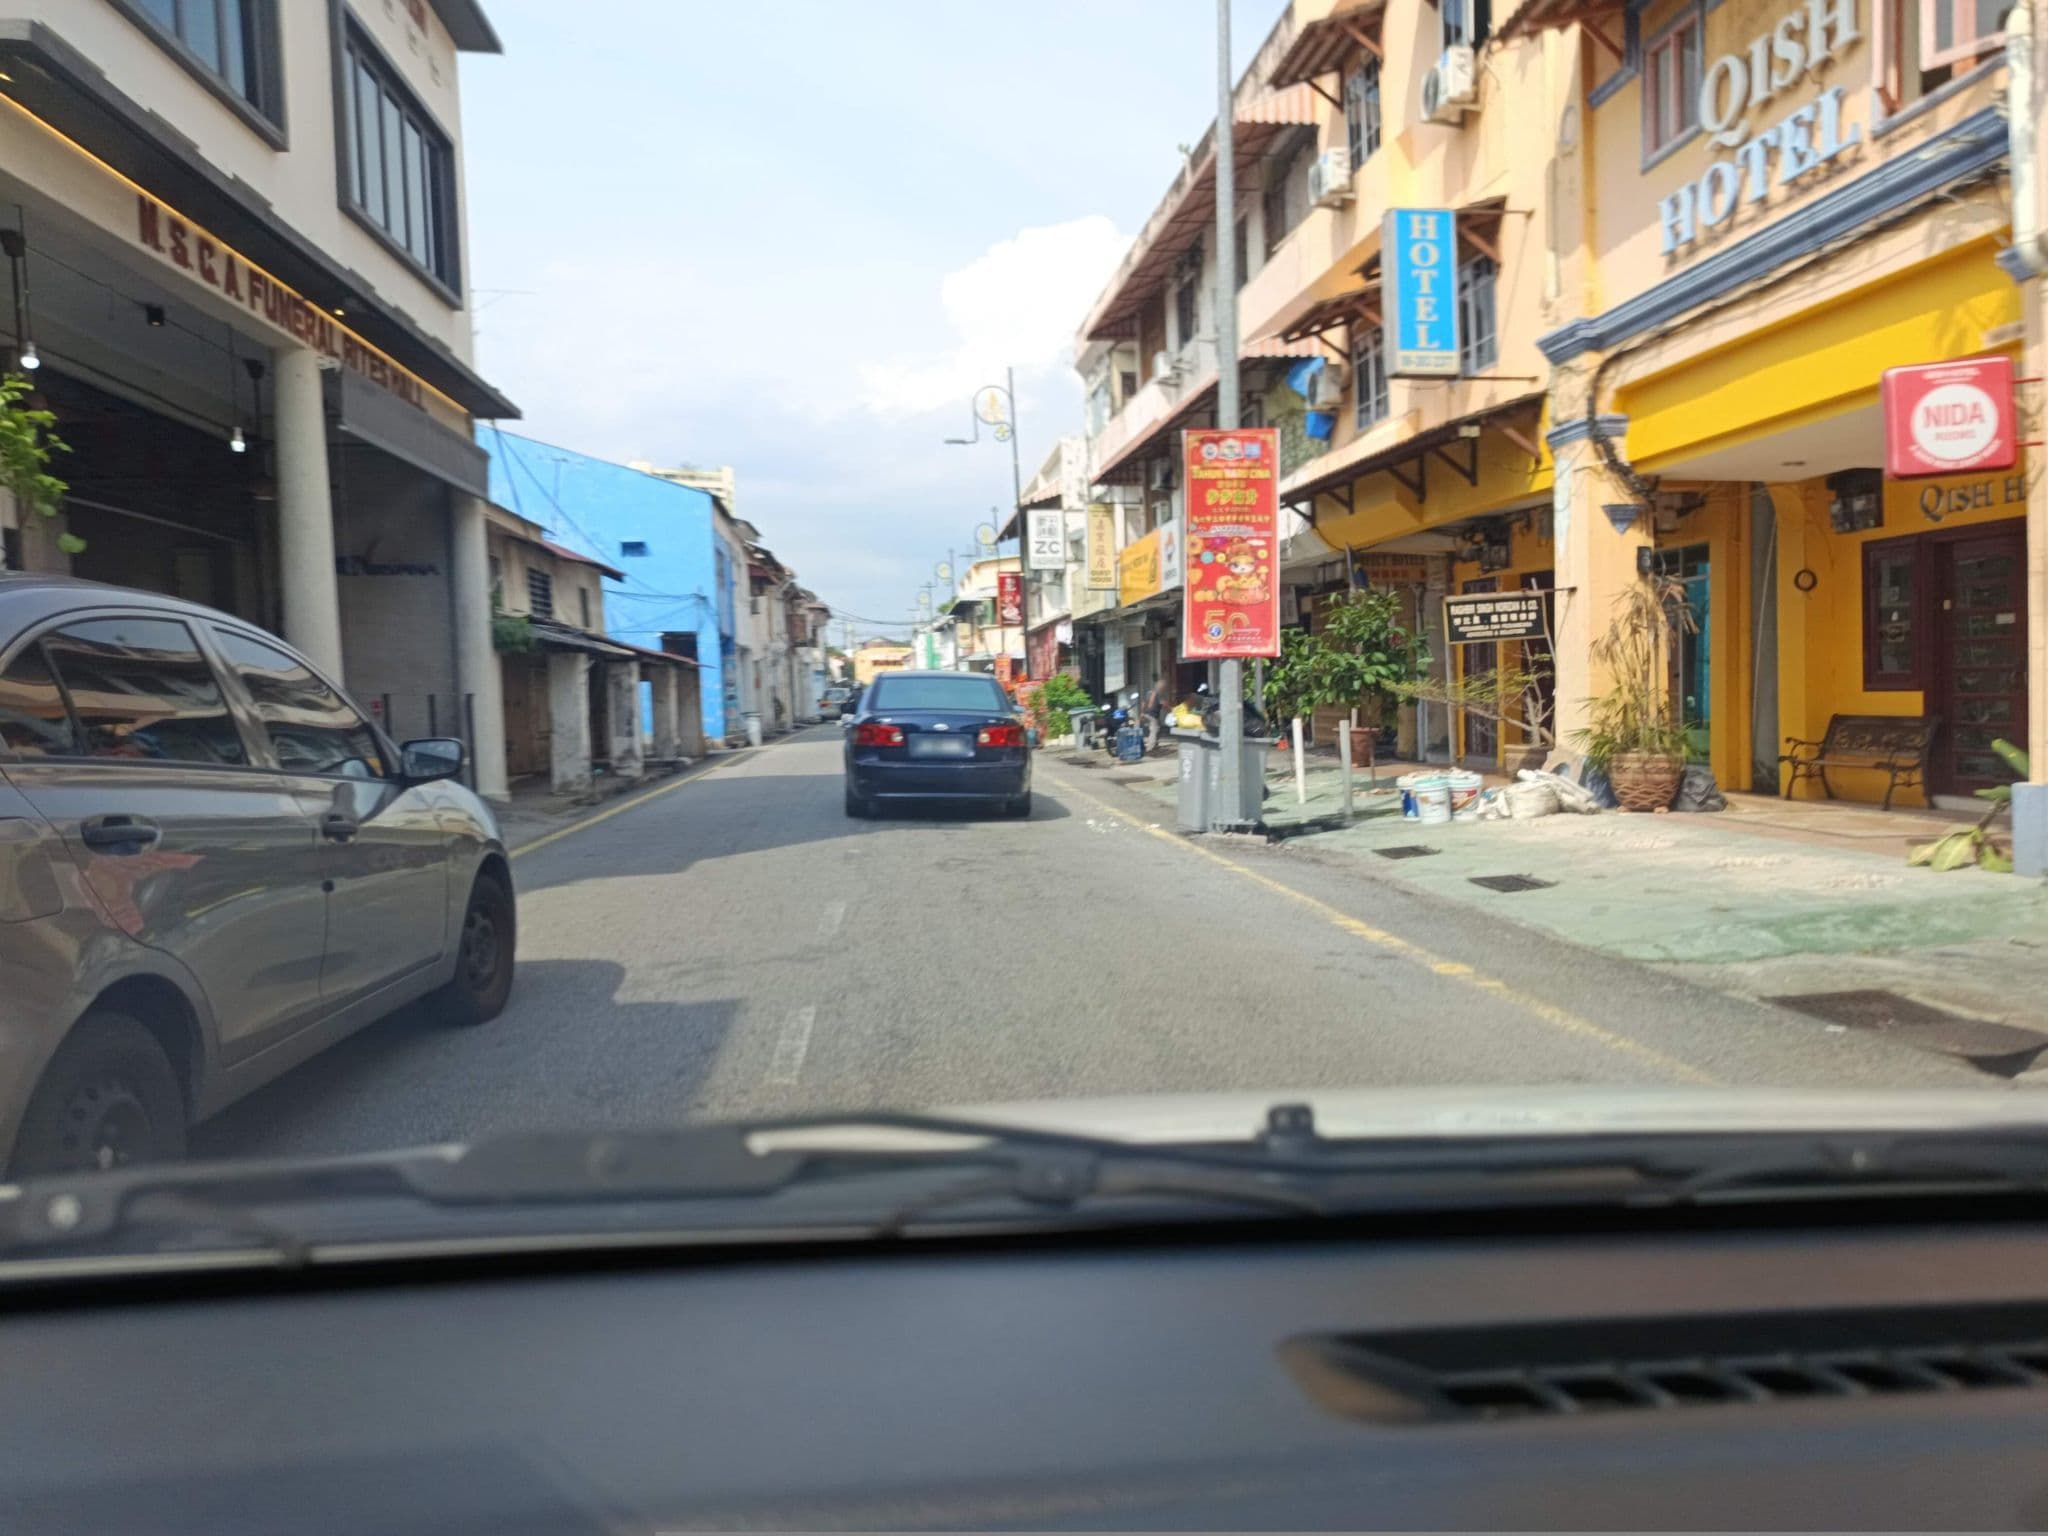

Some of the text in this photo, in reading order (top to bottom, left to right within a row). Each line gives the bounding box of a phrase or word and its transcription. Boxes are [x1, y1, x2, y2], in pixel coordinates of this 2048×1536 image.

[1700, 0, 1861, 151] QISH
[1658, 84, 1863, 257] HOTEL
[1409, 213, 1440, 350] HOTEL
[1924, 402, 1985, 428] NIDA
[1920, 480, 1995, 522] QISH
[1034, 540, 1060, 554] ZC
